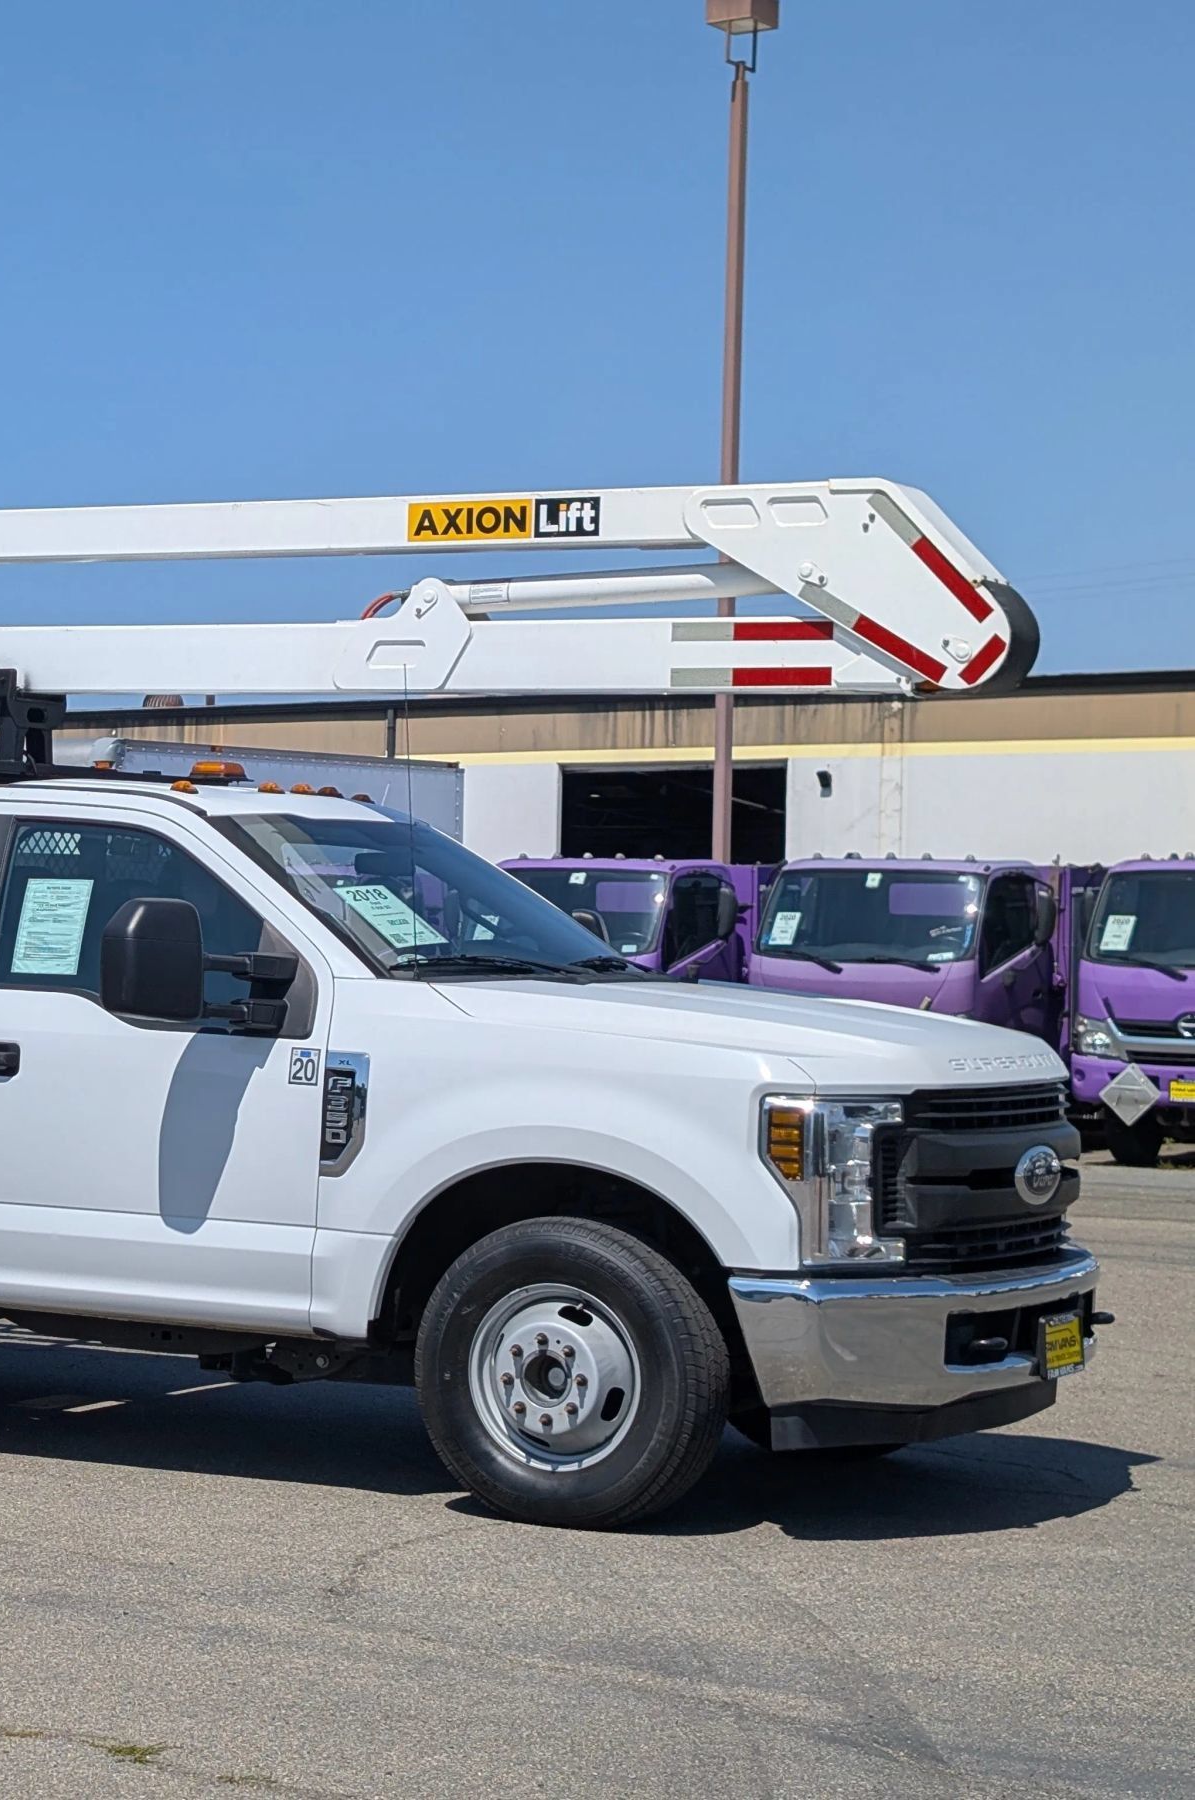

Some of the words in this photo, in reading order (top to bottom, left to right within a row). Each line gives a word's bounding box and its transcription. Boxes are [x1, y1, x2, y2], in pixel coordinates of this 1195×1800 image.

[414, 505, 527, 536] AXION
[539, 501, 595, 532] Lift
[346, 888, 388, 902] 2018
[291, 1058, 316, 1082] 20
